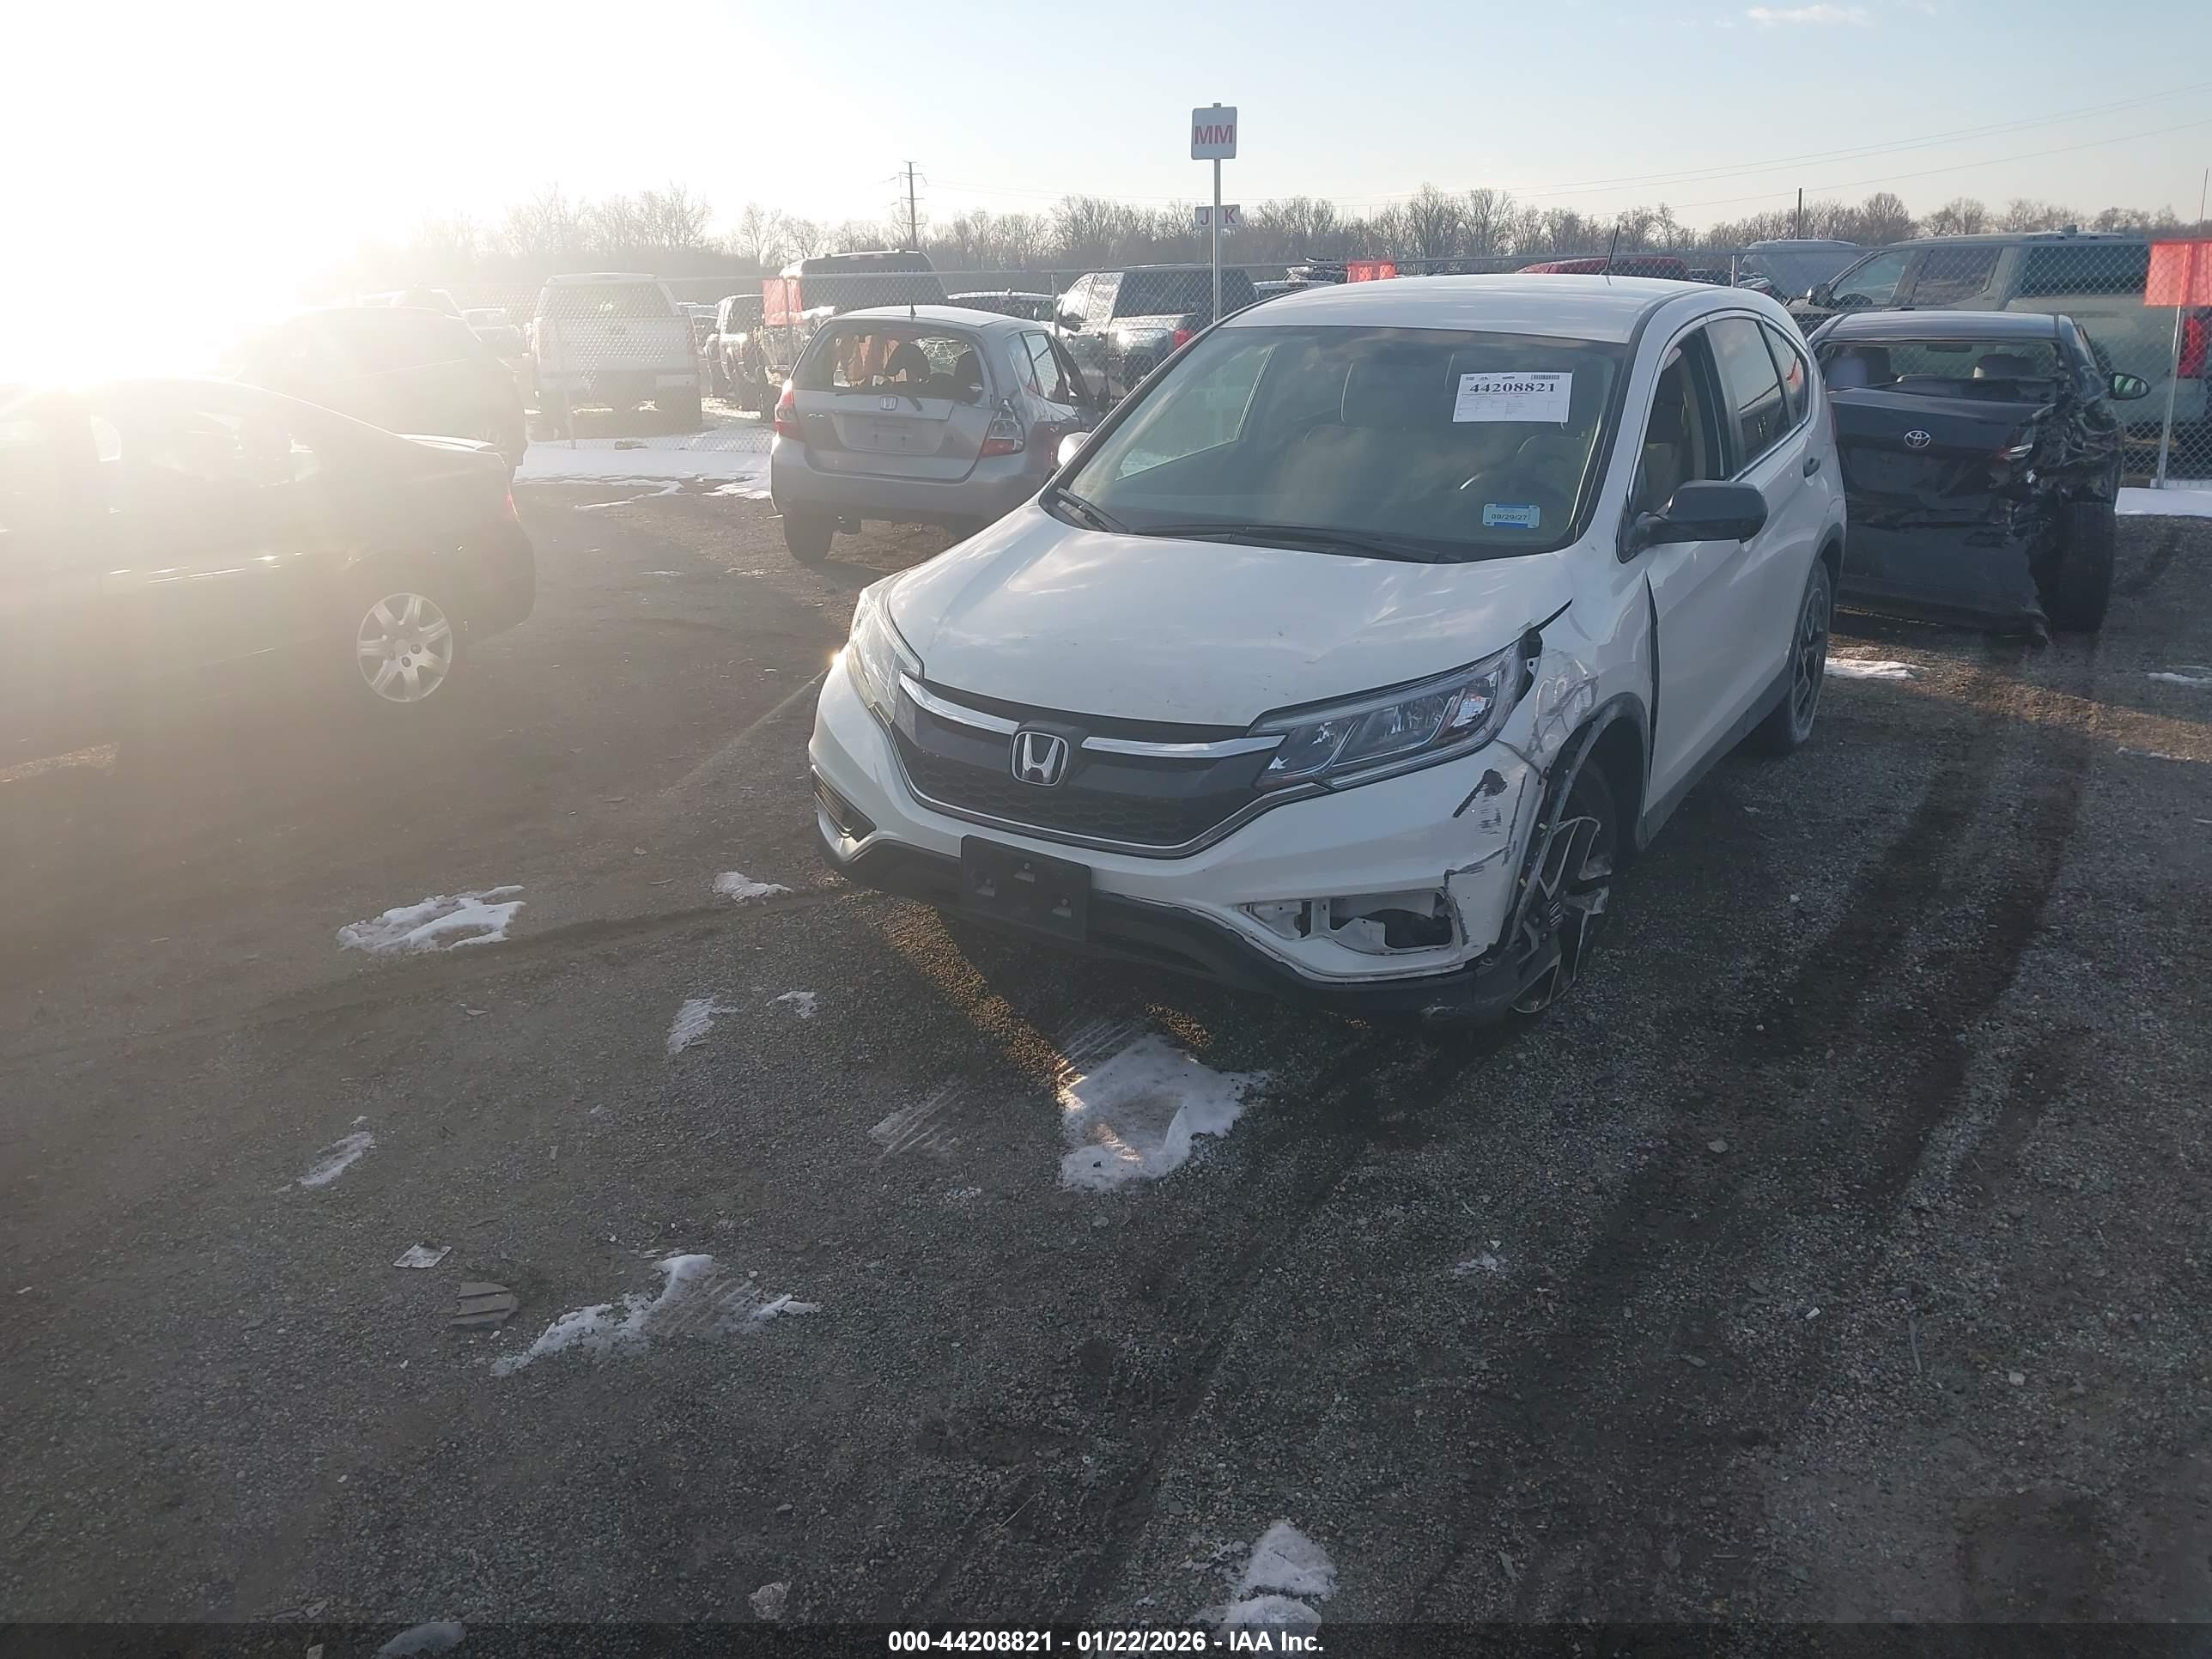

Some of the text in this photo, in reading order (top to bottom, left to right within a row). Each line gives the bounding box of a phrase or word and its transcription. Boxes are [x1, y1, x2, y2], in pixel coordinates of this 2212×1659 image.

[1194, 124, 1233, 144] MM
[1200, 210, 1210, 225] J
[1224, 209, 1237, 224] K
[1469, 382, 1555, 392] 44208821
